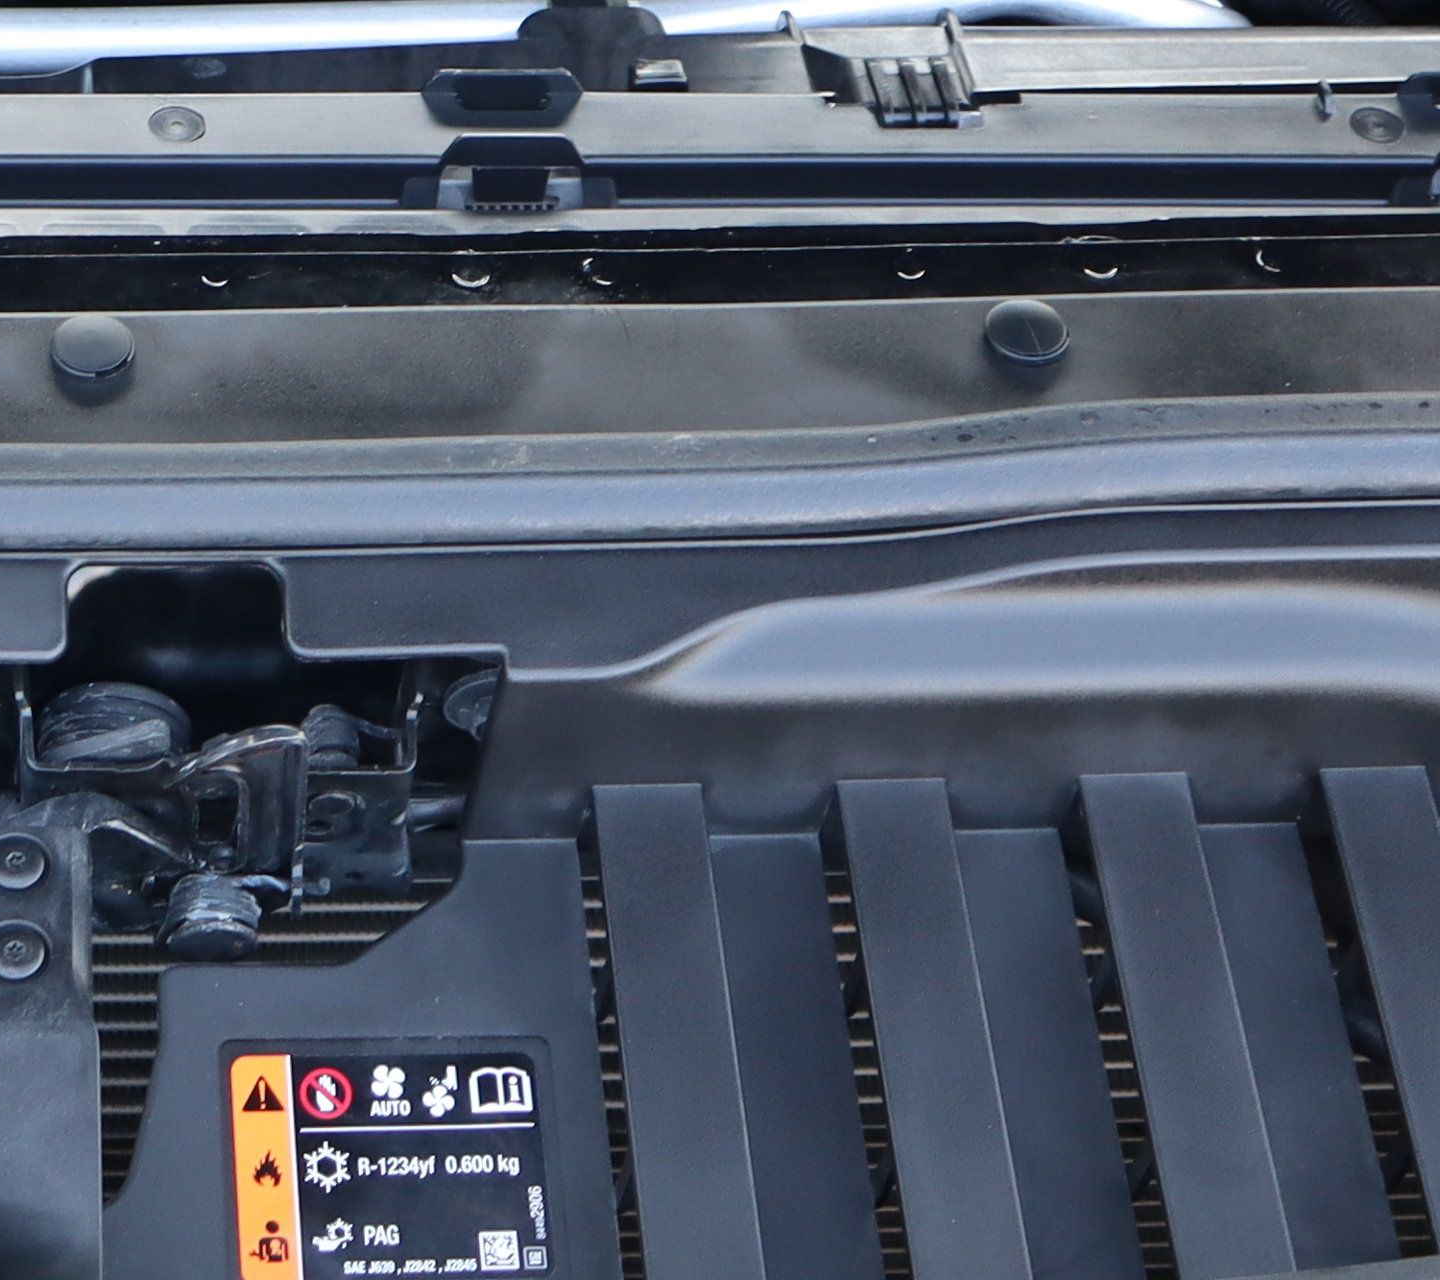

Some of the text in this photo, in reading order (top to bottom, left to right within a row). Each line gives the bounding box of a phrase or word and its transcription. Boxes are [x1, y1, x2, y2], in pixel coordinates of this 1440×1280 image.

[370, 1099, 411, 1117] AUTO
[357, 1154, 520, 1179] R-1234yf 0.600 kg
[363, 1224, 401, 1246] PAG
[343, 1260, 367, 1275] SAE
